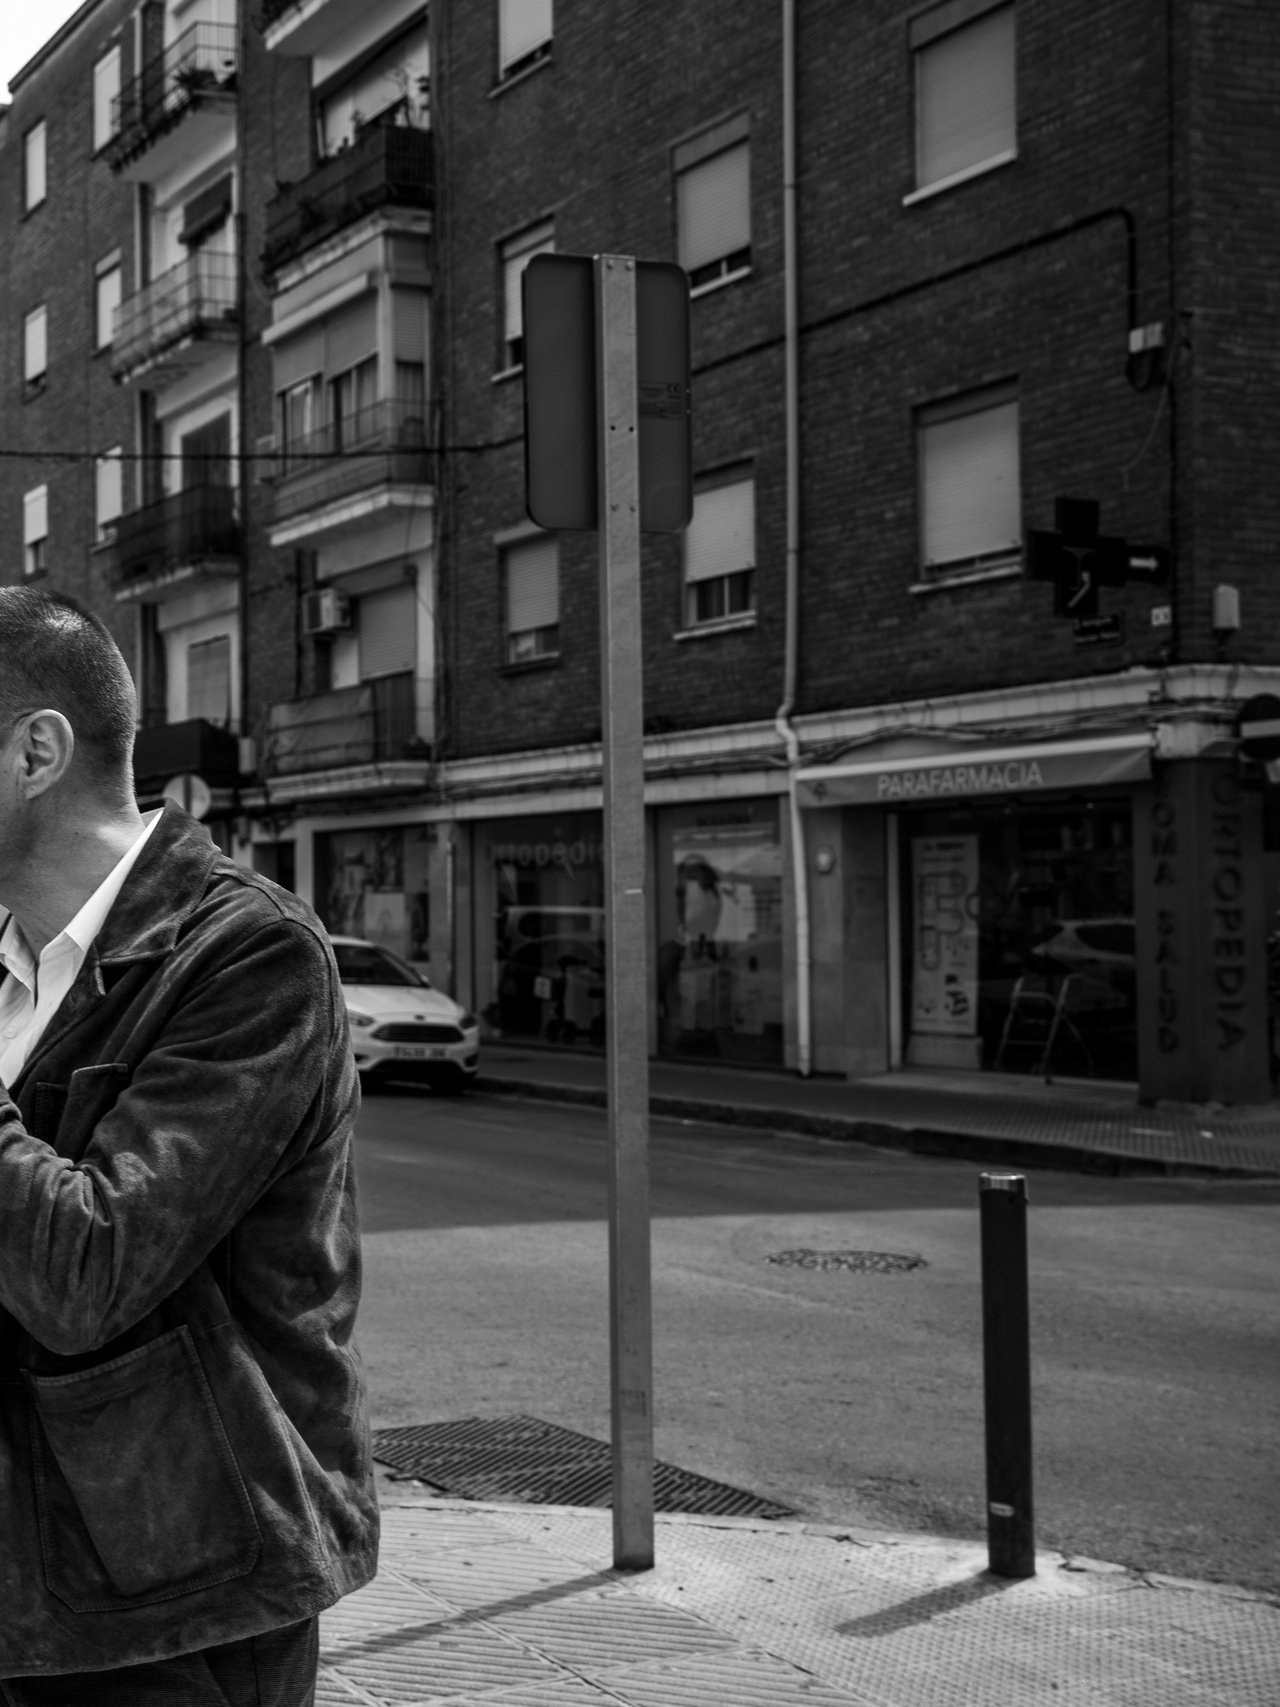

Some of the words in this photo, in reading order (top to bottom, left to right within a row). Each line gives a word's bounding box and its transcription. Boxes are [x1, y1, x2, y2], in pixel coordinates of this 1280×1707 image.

[877, 761, 1044, 799] PARAFARMACIA
[1154, 909, 1180, 1054] SALUD
[1211, 772, 1247, 1051] ORTOPEDIA
